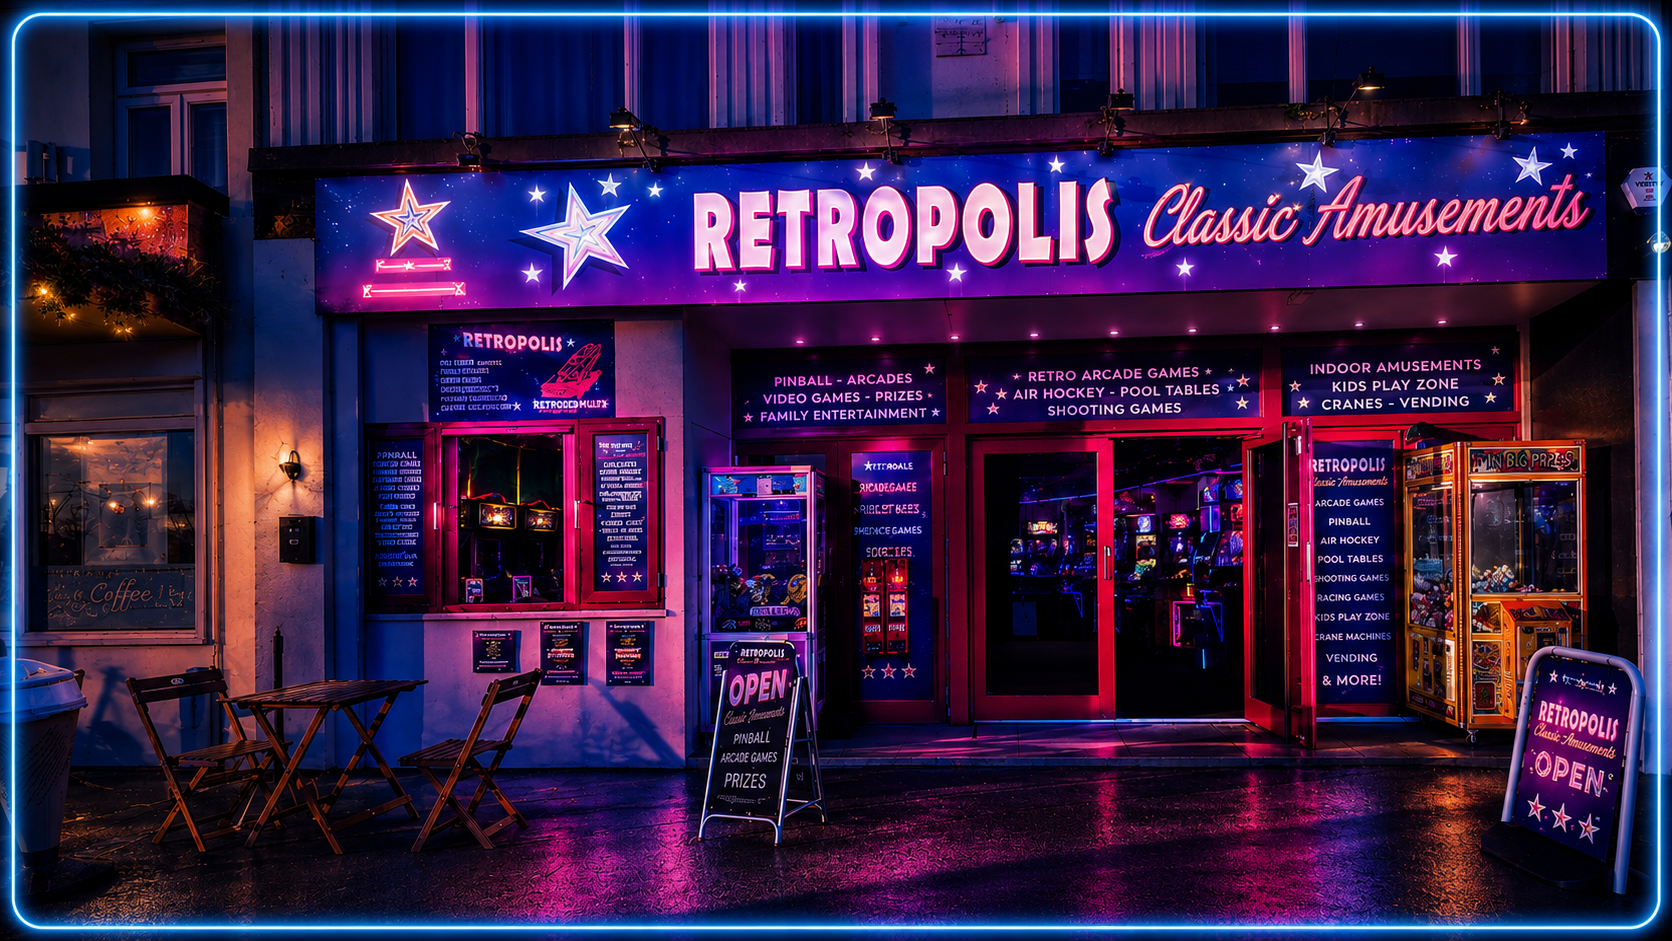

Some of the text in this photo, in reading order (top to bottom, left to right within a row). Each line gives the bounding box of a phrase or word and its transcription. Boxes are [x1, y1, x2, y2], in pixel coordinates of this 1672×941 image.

[693, 173, 1589, 271] RETROPOLIS Classic Amusements
[462, 331, 563, 353] RETROPOLIS
[1028, 366, 1200, 382] RETRO ARCADE GAMES
[1310, 359, 1482, 375] INDOOR AMUSEMENTS
[774, 375, 833, 387] PINBALL
[846, 373, 913, 385] ARCADES
[1332, 378, 1459, 393] KIDS PLAY ZONE
[763, 393, 808, 405] VIDEO
[811, 391, 861, 404] GAMES
[875, 390, 924, 402] PRIZES
[1013, 388, 1038, 400] AIR
[1043, 386, 1105, 400] HOCKEY
[1120, 385, 1163, 398] POOL
[1166, 383, 1220, 396] TABLES
[1048, 402, 1182, 417] SHOOTING GAMES
[1321, 397, 1383, 410] CRANES
[1399, 395, 1470, 408] VENDING
[760, 408, 927, 422] FAMILY ENTERTAINMENT
[1315, 498, 1385, 507] ARCADE GAMES
[1328, 517, 1371, 526] PINBALL
[891, 526, 922, 535] GAMES
[1320, 535, 1380, 546] AIR HOCKEY
[1317, 554, 1384, 564] POOL TABLES
[1359, 573, 1390, 582] GAMES
[90, 577, 153, 613] Coffee
[1316, 593, 1385, 602] RACING GAMES
[1338, 612, 1362, 621] PLAY
[1364, 612, 1390, 621] ZONE
[1345, 632, 1392, 641] MACHINES
[1325, 653, 1378, 663] VENDING
[728, 668, 788, 707] OPEN
[1322, 674, 1382, 686] & MORE!
[1537, 700, 1619, 742] RETROPOLIS
[733, 730, 771, 745] PINBALL
[1561, 732, 1617, 760] Amusements
[720, 751, 778, 764] ARCADE GAMES
[724, 772, 767, 789] PRIZES
[1534, 750, 1605, 798] OPEN
